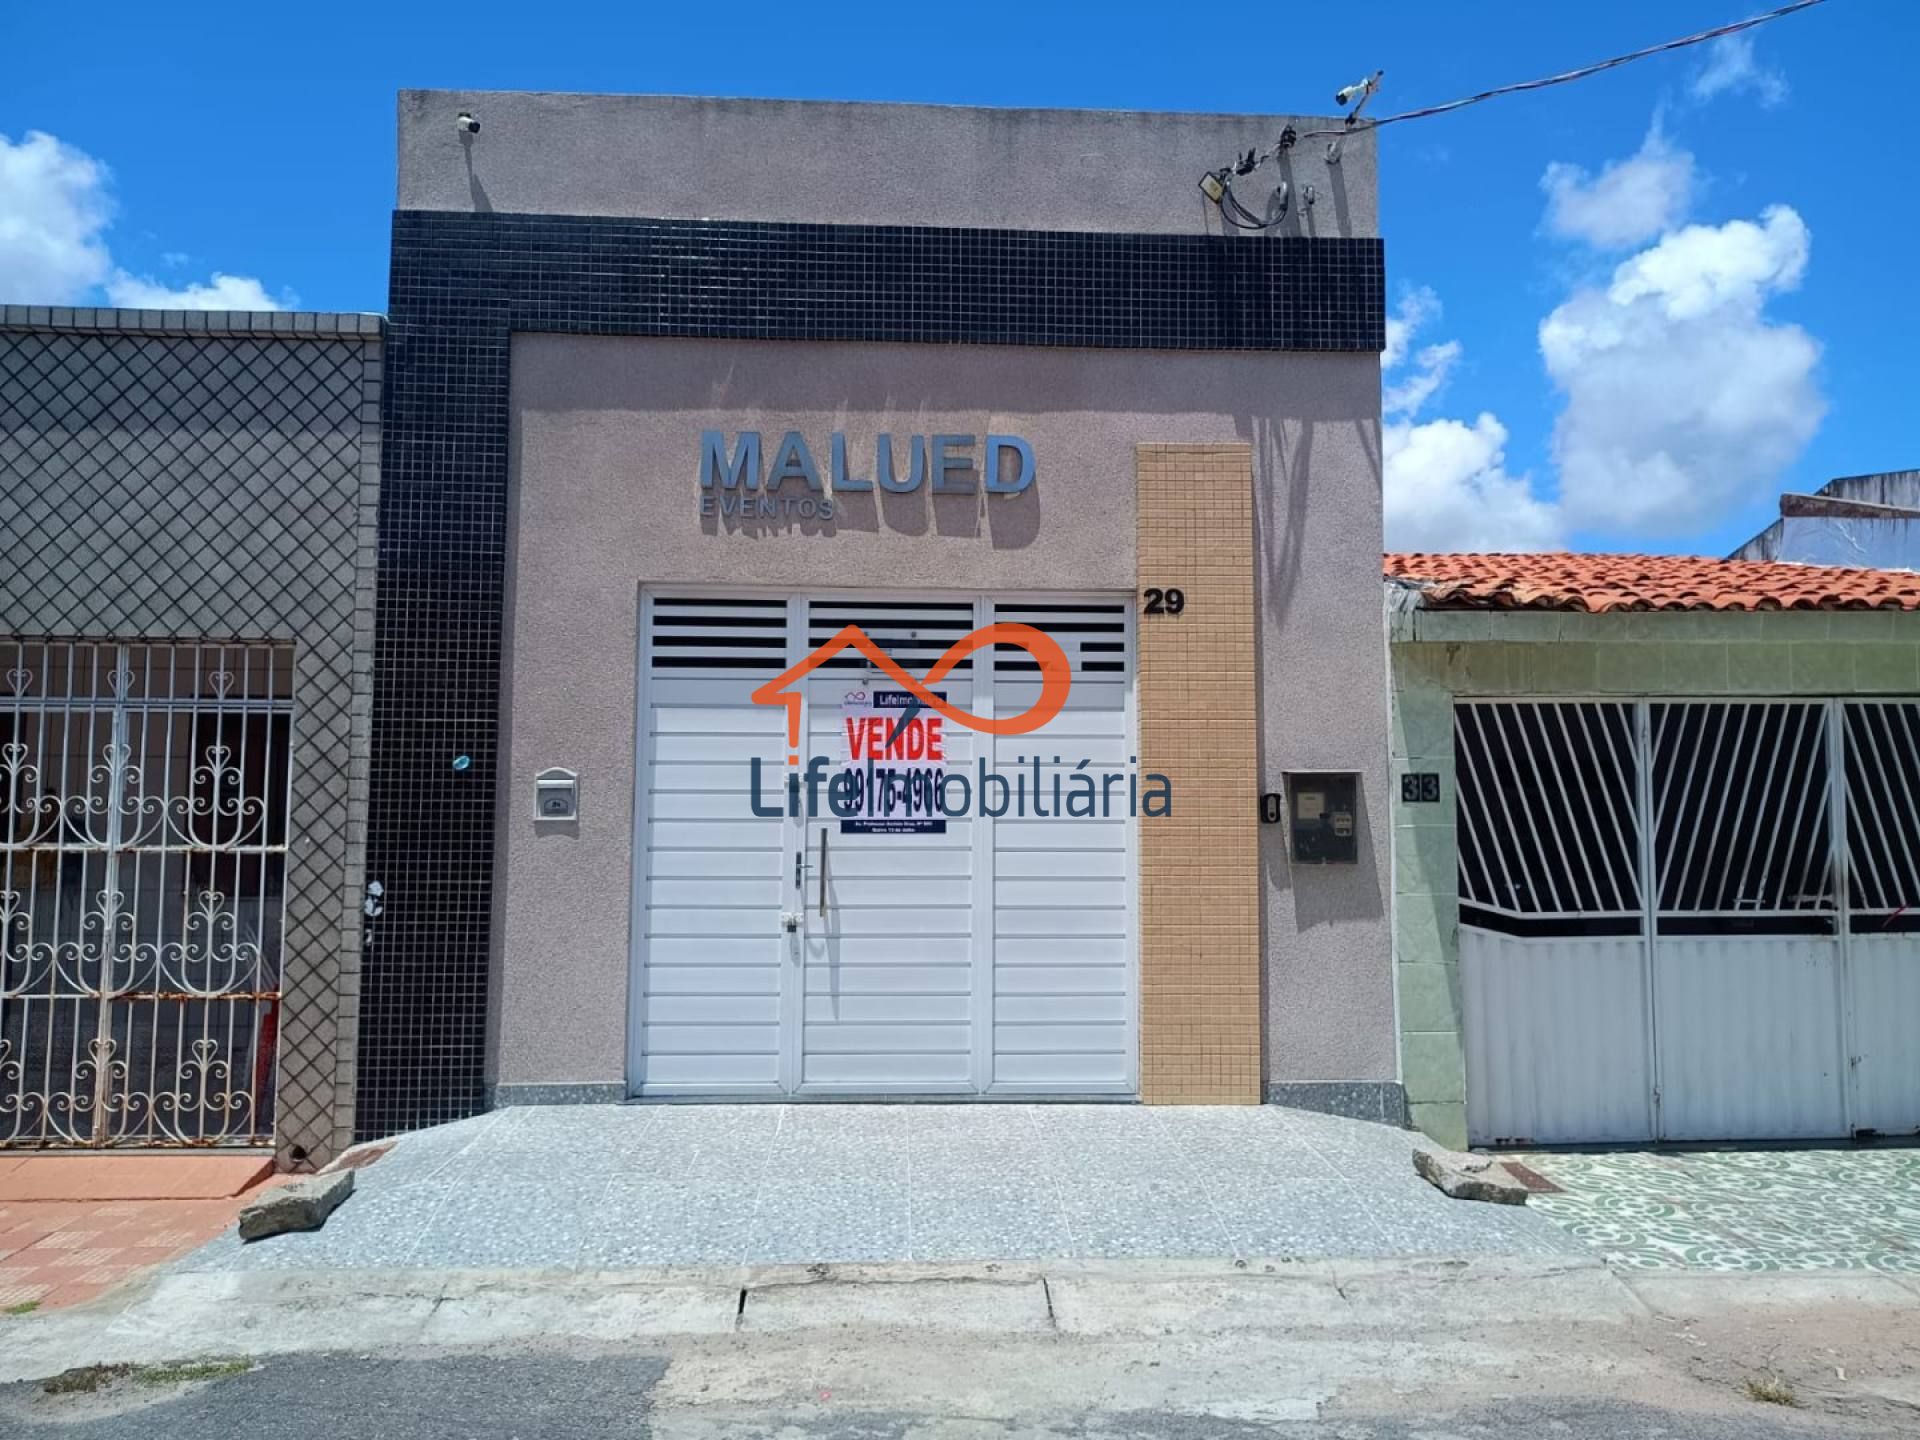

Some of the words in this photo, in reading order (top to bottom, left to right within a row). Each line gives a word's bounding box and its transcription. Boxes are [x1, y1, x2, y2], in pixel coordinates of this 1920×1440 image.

[701, 429, 1037, 494] MALUED
[700, 495, 834, 520] EVENTOS
[1144, 588, 1185, 614] 29
[846, 716, 943, 760] VENDE
[1404, 776, 1438, 800] 33
